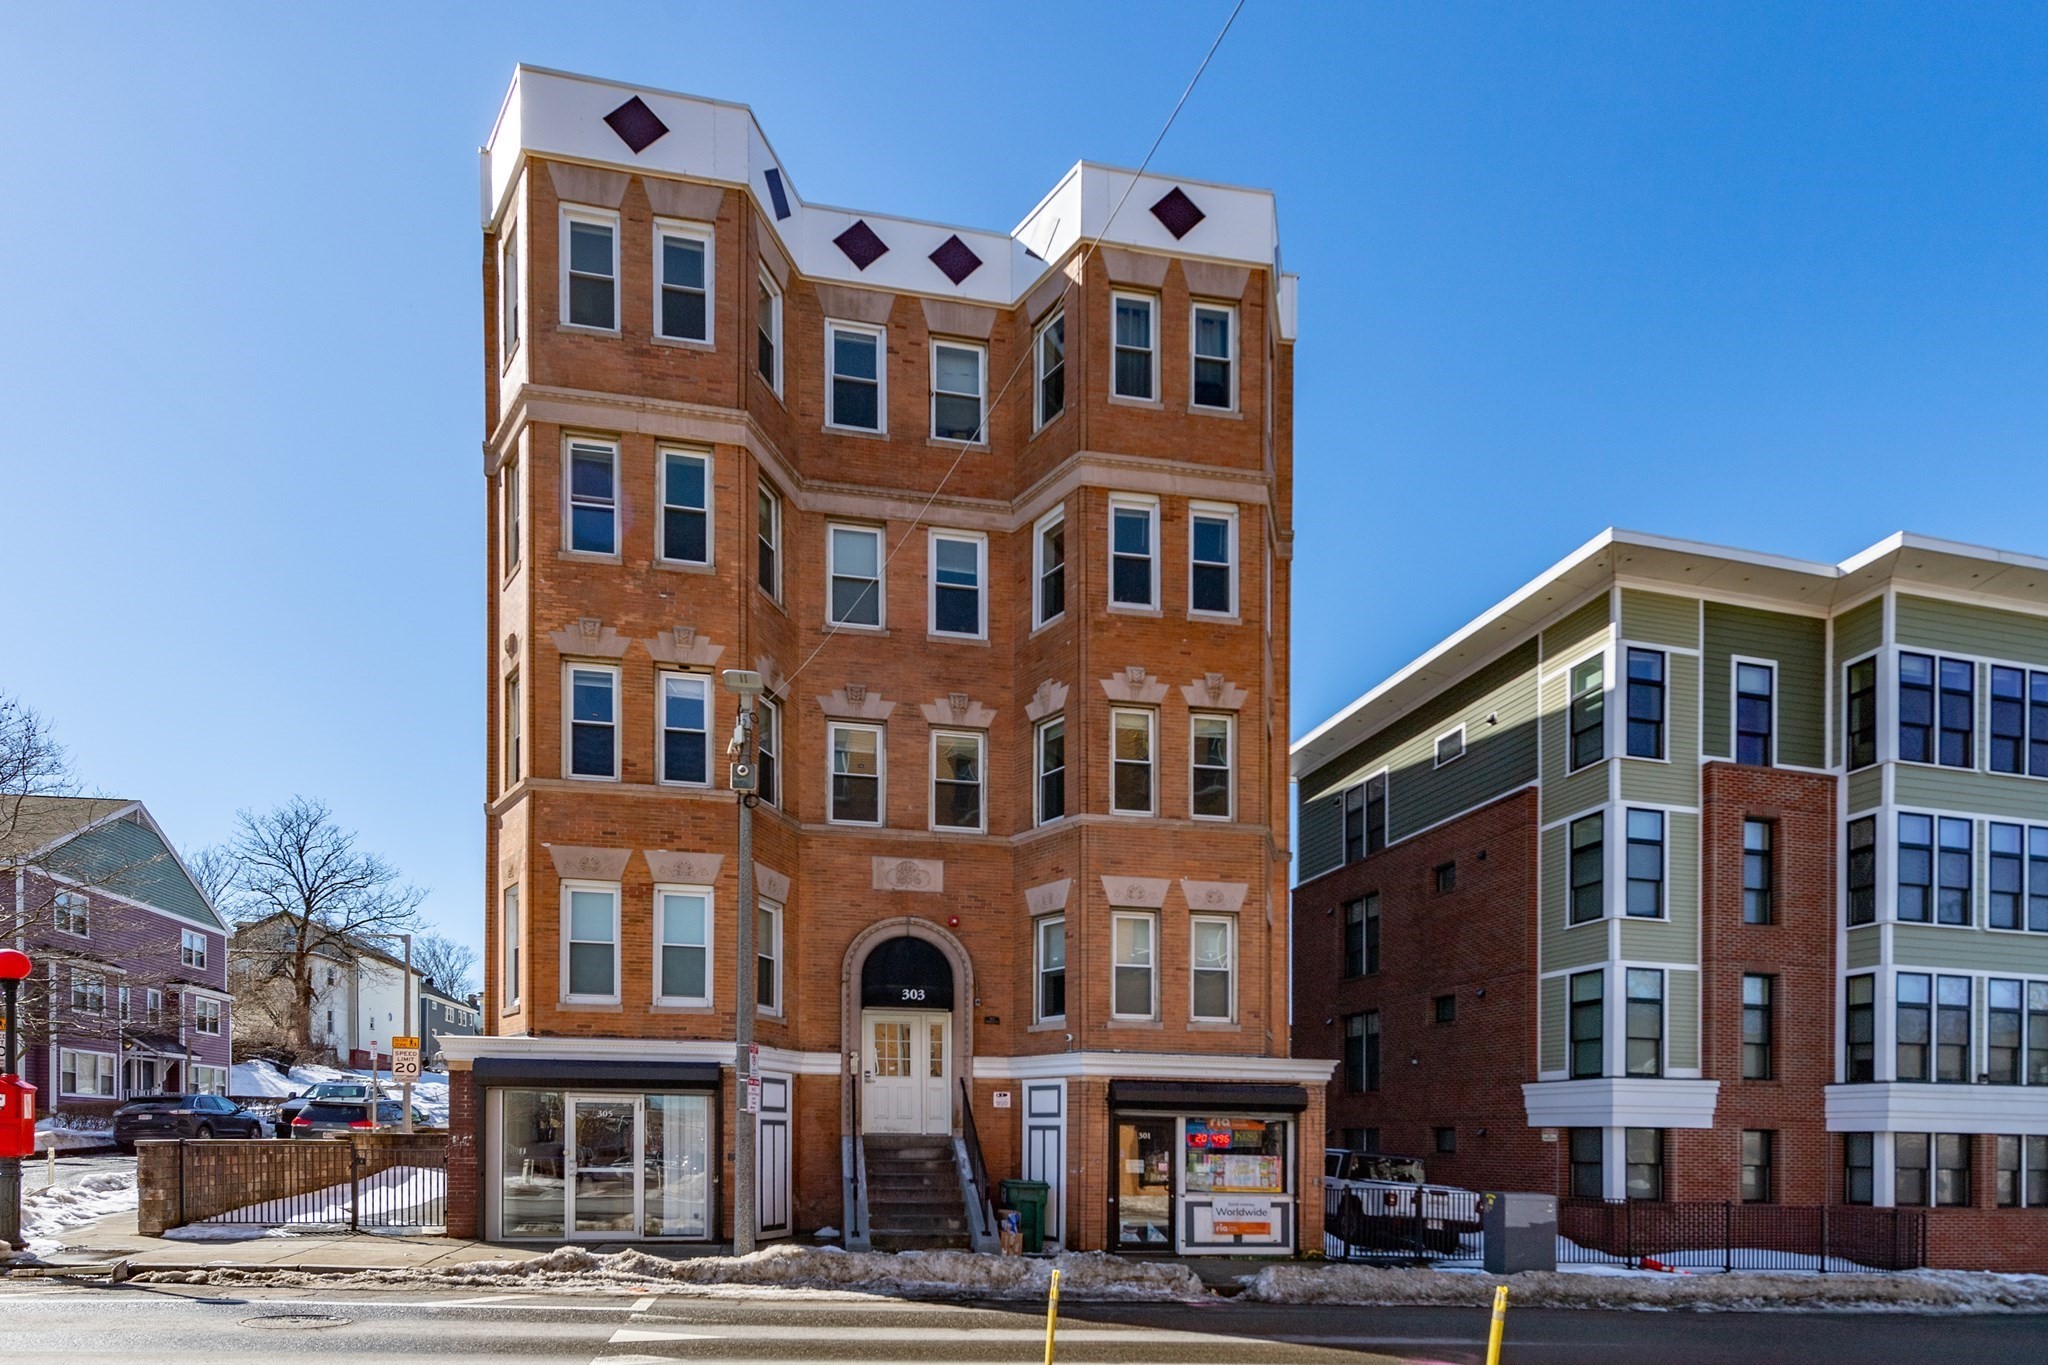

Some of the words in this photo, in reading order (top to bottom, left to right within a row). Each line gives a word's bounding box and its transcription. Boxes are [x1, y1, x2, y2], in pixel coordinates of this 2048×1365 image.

[902, 989, 925, 1000] 303
[395, 1063, 417, 1073] 20
[597, 1110, 613, 1118] 305
[1138, 1132, 1151, 1140] 301
[1215, 1208, 1268, 1216] Worldwide
[1216, 1223, 1229, 1232] ria
